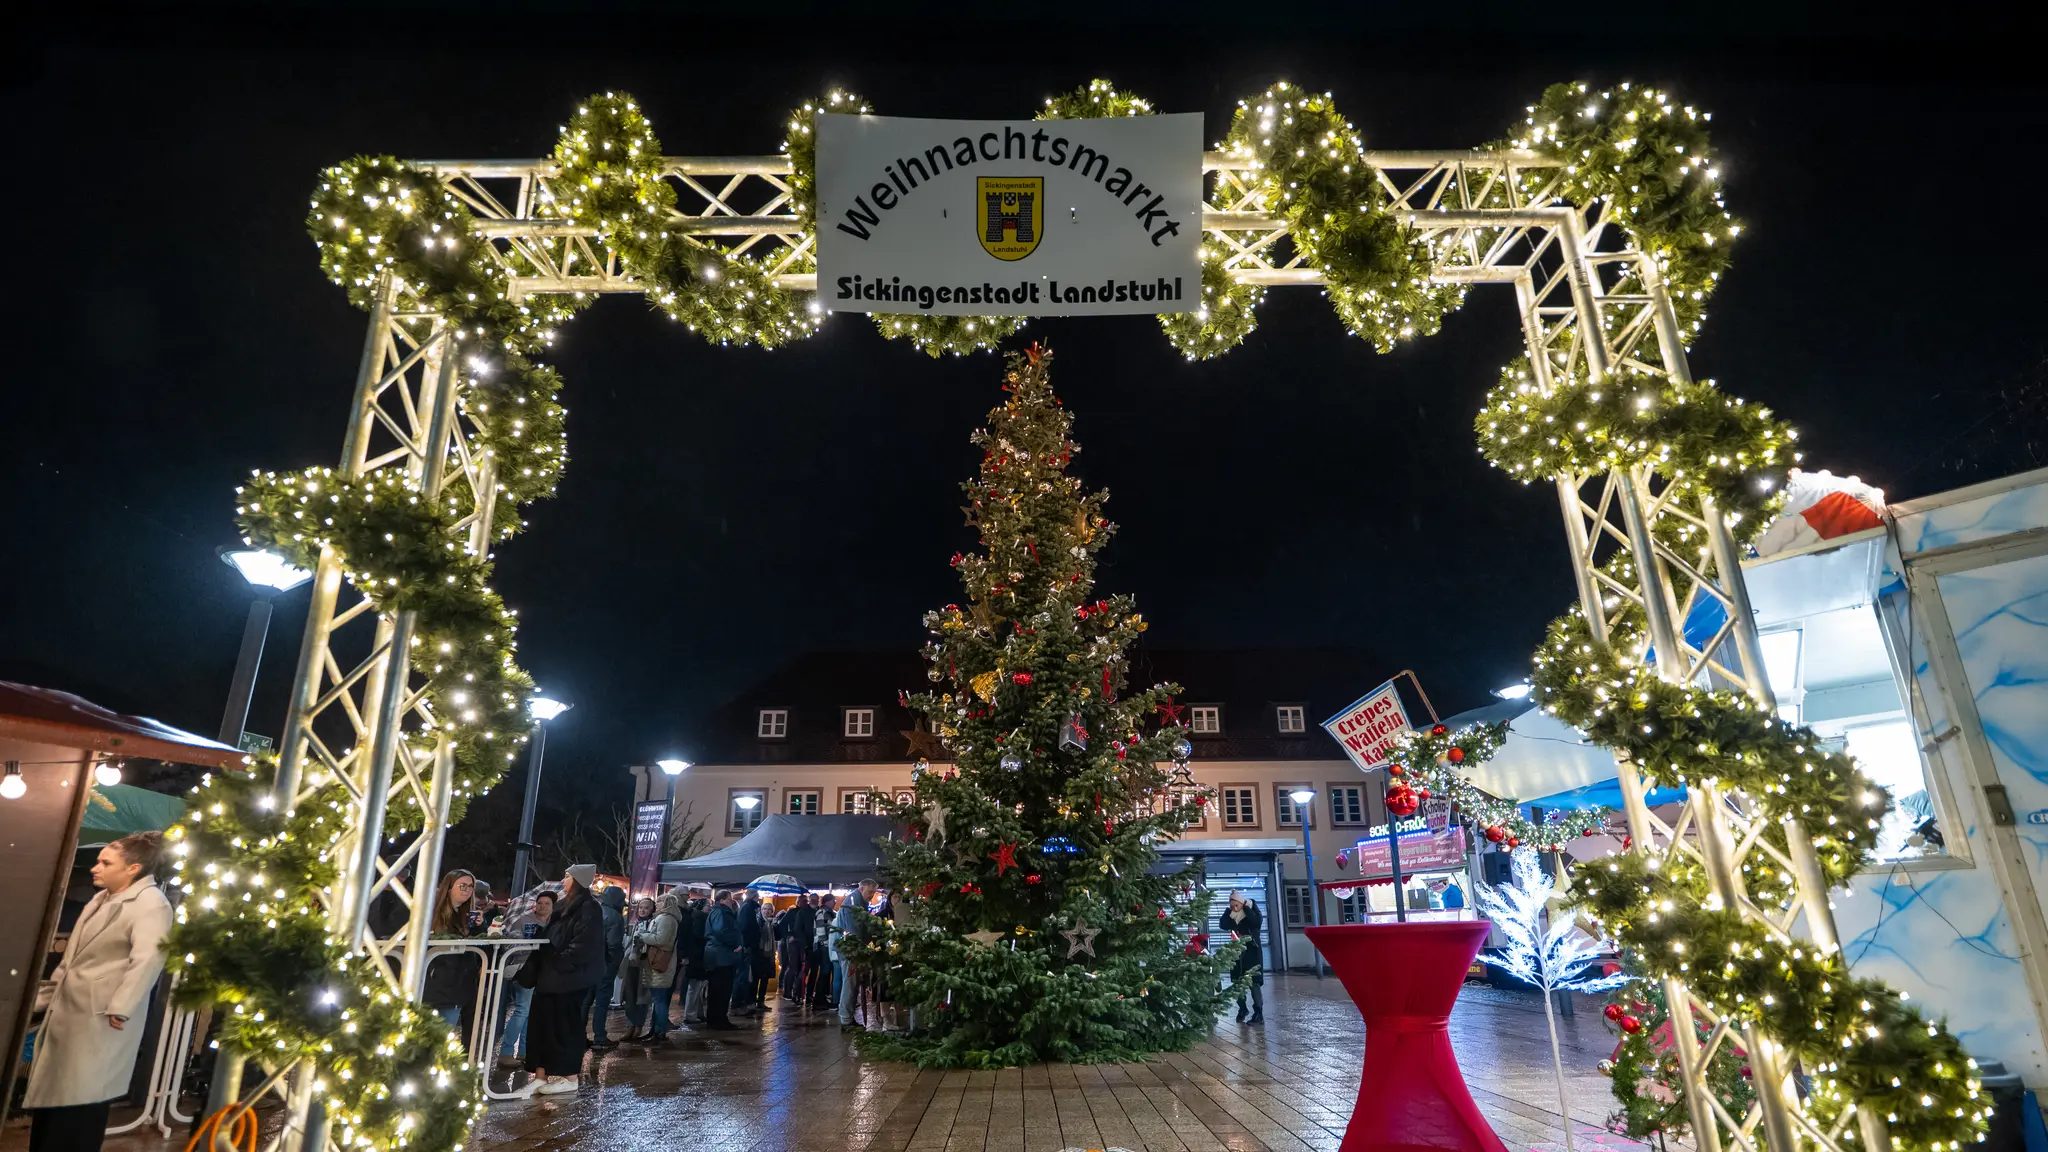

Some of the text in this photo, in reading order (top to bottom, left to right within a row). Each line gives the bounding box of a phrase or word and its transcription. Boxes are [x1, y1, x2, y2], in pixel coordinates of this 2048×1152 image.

[836, 126, 1180, 247] Weihnachtsmarkt
[984, 182, 1036, 190] Sickingenstadt
[836, 274, 1182, 309] Sickingenstadt Landstuhl
[1337, 696, 1392, 735] Crêpes
[1344, 711, 1404, 752] Waffeln
